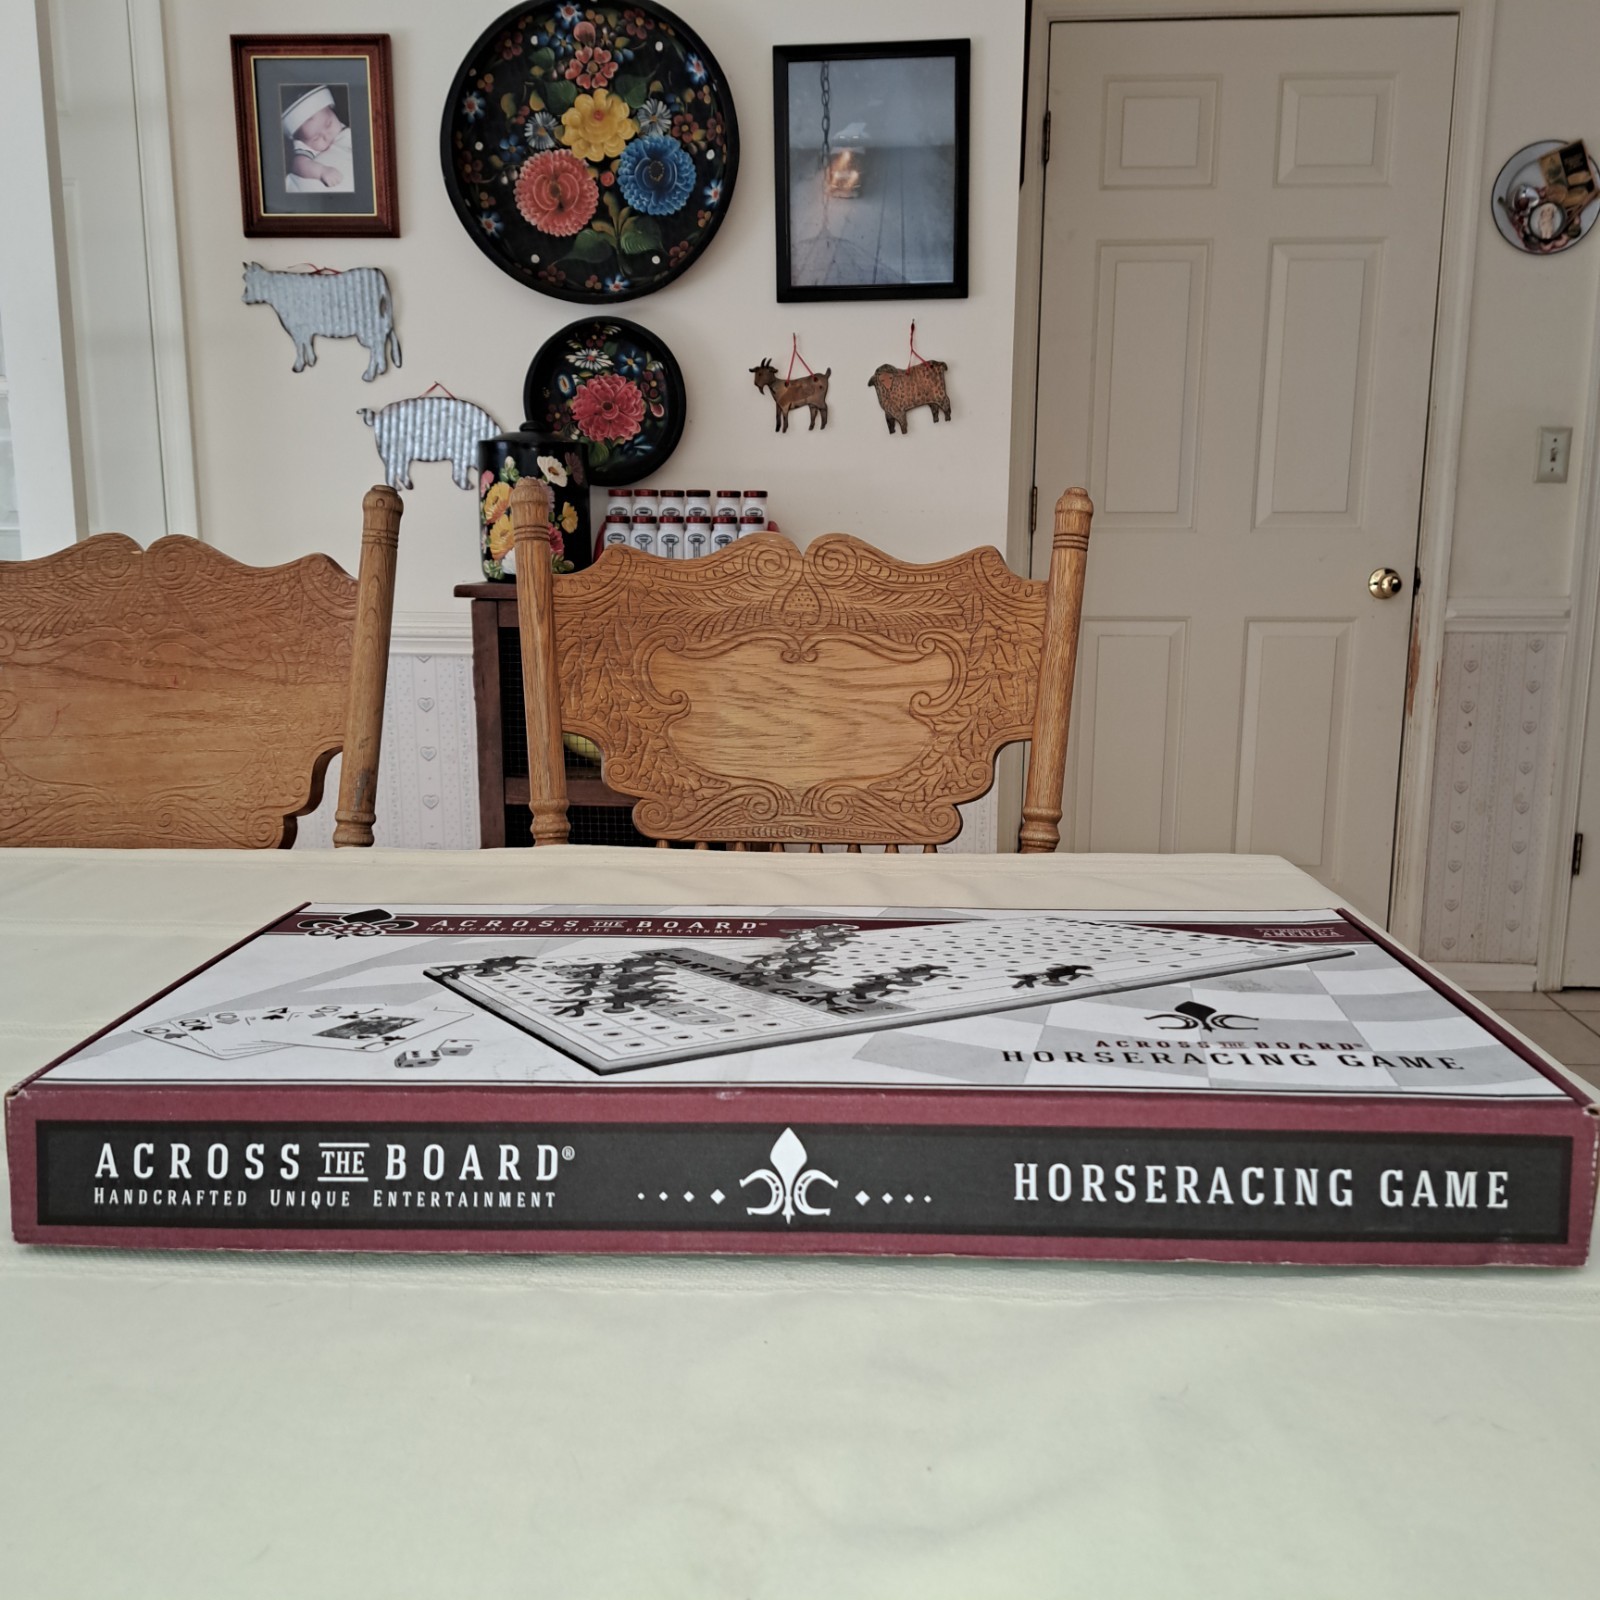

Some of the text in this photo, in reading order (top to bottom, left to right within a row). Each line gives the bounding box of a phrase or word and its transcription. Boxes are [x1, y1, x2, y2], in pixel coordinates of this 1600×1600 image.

[431, 919, 581, 928] ACROSS
[590, 919, 627, 928] THE
[626, 927, 754, 935] ENTERTAINMENT
[1095, 1039, 1210, 1050] ACROSS
[1002, 1050, 1466, 1071] HORSERACING GAME
[94, 1142, 301, 1180] ACROSS
[321, 1151, 366, 1175] THE
[1013, 1162, 1510, 1210] HORSERACING GAME
[93, 1186, 557, 1210] HANDCRAFTED UNIQUE ENTERTAINMENT
